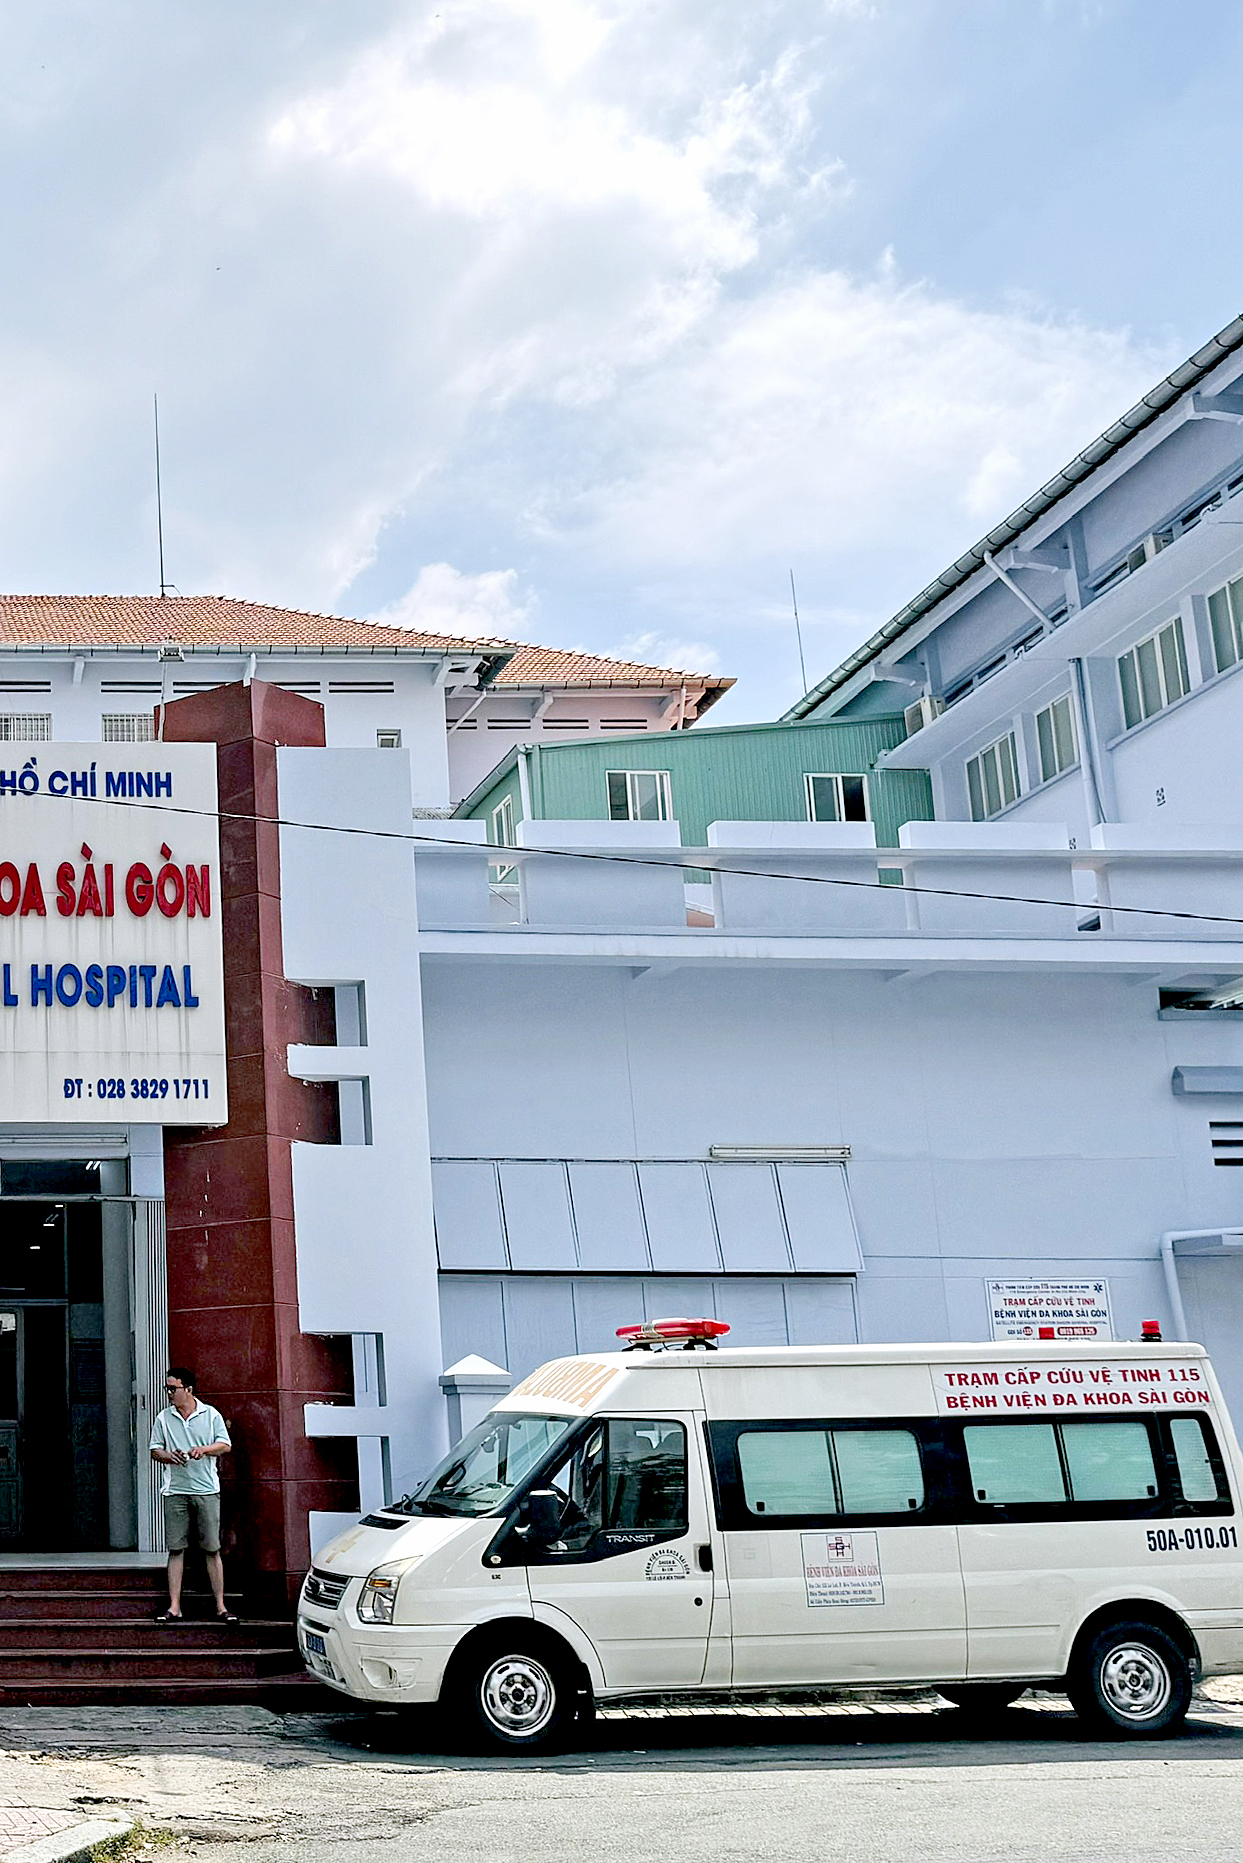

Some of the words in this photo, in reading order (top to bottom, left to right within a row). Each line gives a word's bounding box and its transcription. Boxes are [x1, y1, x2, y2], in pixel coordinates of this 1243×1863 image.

[0, 757, 40, 796] HỒ
[48, 762, 97, 797] CHÍ
[105, 771, 172, 798] MINH
[56, 842, 115, 918] SÀI
[125, 842, 211, 918] GÒN
[31, 963, 199, 1008] HOSPITAL
[63, 1078, 83, 1099] ĐT
[97, 1078, 126, 1099] 028
[130, 1078, 169, 1099] 3829
[173, 1079, 209, 1099] 1711
[1078, 1298, 1095, 1306] TINH
[945, 1372, 999, 1388] TRẠM
[1005, 1366, 1041, 1385] CẤP
[1047, 1367, 1084, 1384] CỨU
[1089, 1366, 1112, 1386] VỆ
[1118, 1368, 1161, 1382] TINH
[1169, 1368, 1200, 1382] 115
[946, 1392, 997, 1411] BỆNH
[1003, 1391, 1046, 1410] VIỆN
[1052, 1392, 1078, 1406] ĐA
[1083, 1391, 1132, 1406] KHOA
[1138, 1388, 1167, 1405] SÀI
[1173, 1387, 1210, 1403] GÒN
[606, 1534, 655, 1543] TRANSIT
[1146, 1526, 1238, 1551] 50A-010.01
